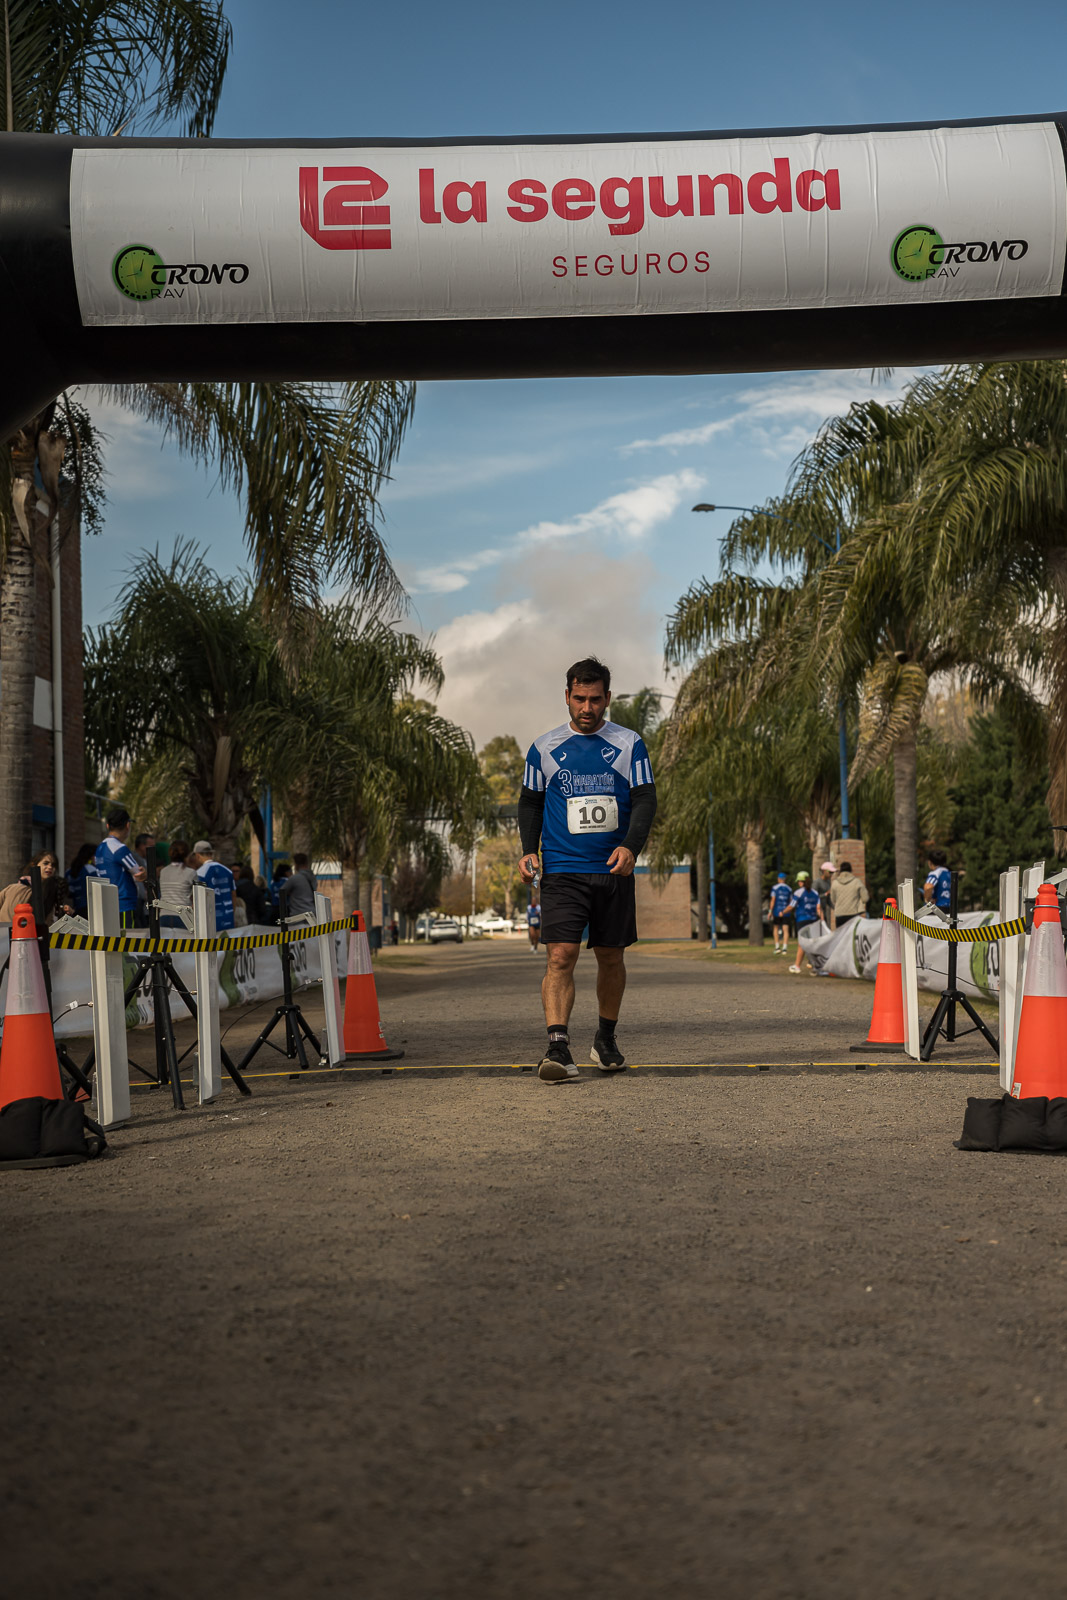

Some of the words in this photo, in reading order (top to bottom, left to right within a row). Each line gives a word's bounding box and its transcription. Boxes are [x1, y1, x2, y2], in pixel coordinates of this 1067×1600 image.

[419, 167, 488, 224] la
[506, 157, 841, 236] segunda
[929, 239, 1029, 265] CRONO
[151, 263, 250, 285] CRONO
[552, 251, 710, 278] SEGUROS
[925, 266, 961, 279] RAV
[150, 288, 186, 299] RAV
[558, 769, 572, 796] 3
[579, 806, 606, 824] 10
